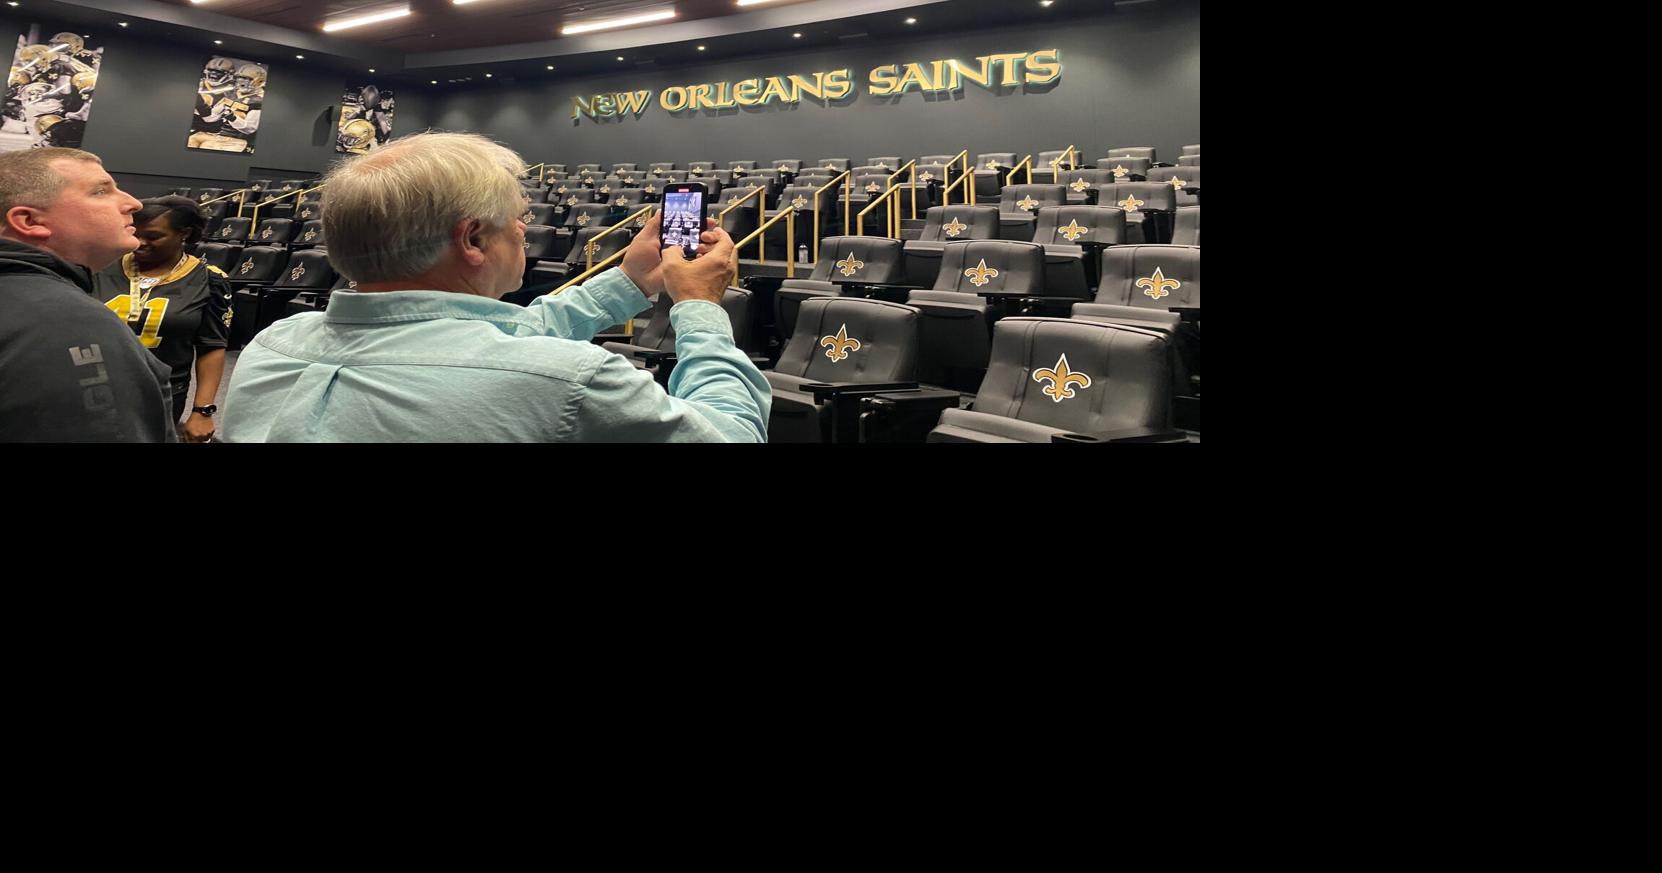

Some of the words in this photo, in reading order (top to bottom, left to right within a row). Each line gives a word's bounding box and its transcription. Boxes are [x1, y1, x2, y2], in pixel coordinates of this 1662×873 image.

[571, 90, 650, 120] NEW
[659, 69, 851, 112] ORLEANS
[869, 49, 1062, 95] SAINTS
